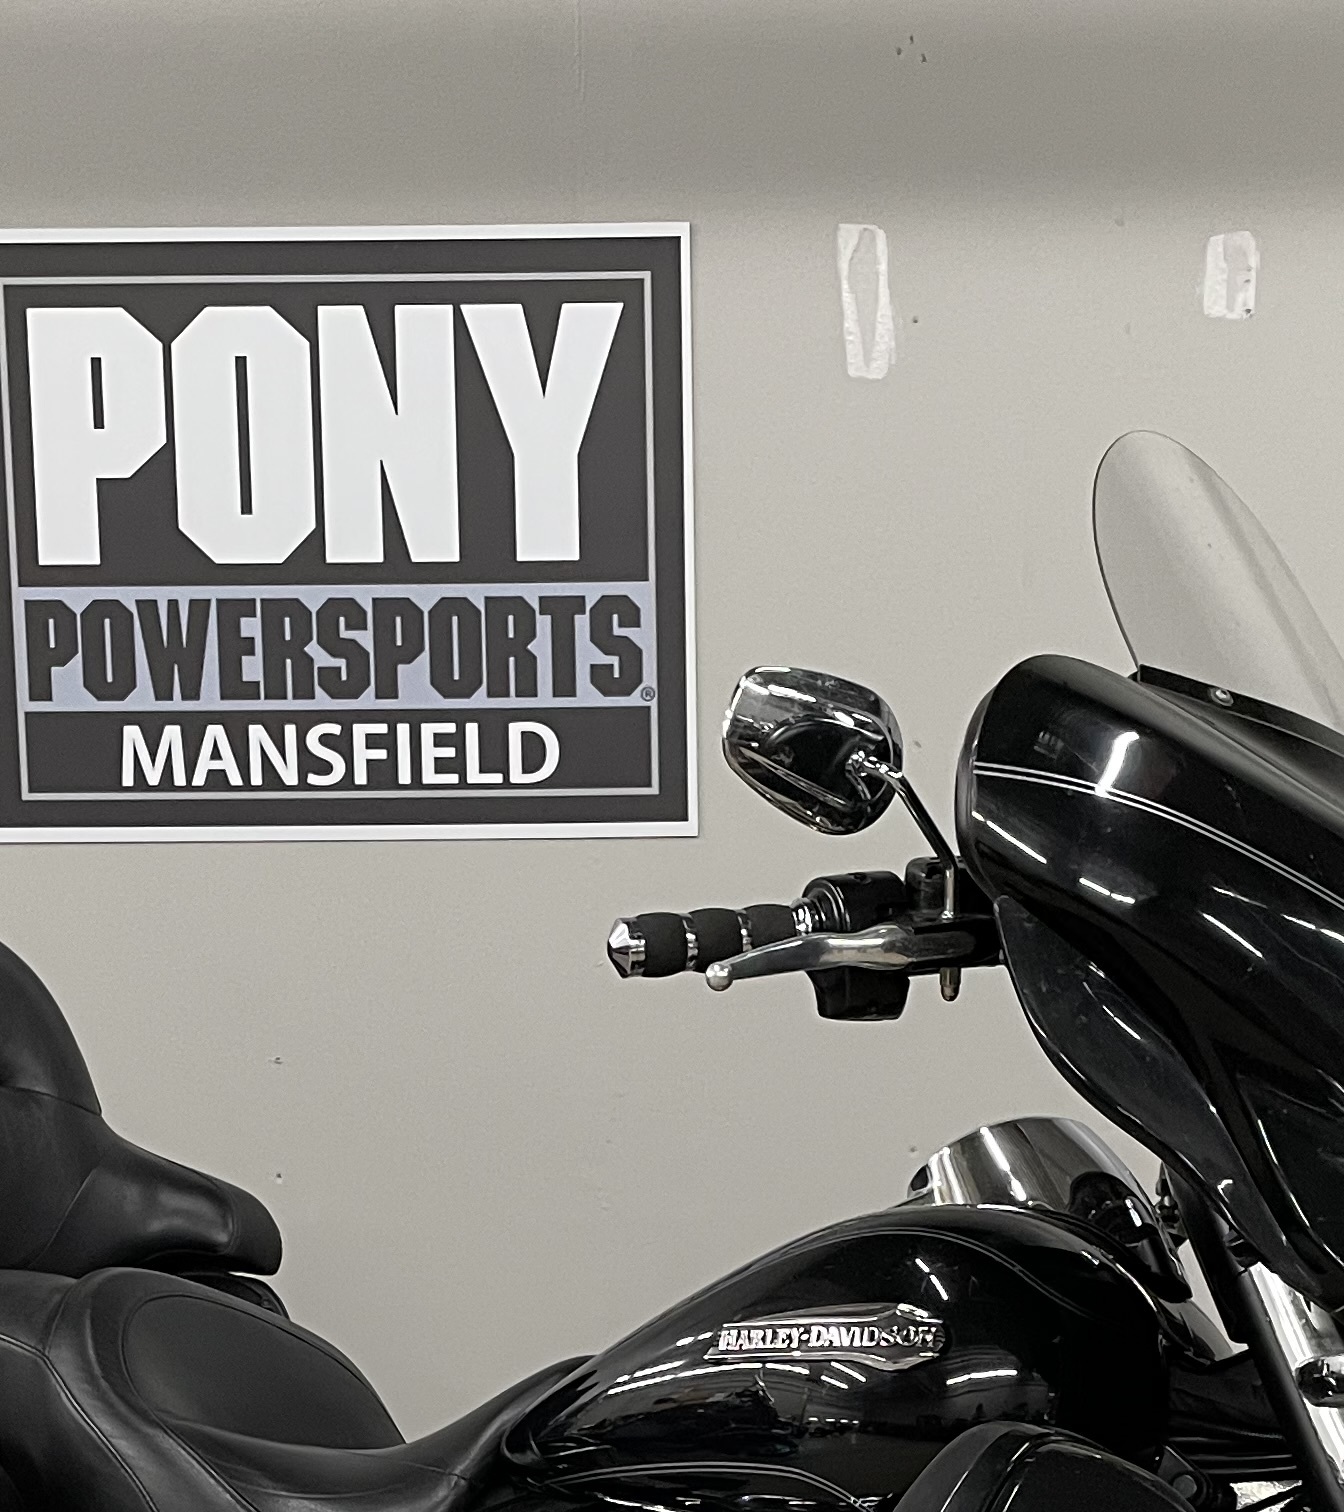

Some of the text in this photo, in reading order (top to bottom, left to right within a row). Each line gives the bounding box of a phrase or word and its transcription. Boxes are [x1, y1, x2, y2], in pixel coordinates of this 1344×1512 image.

[26, 302, 624, 566] PONY
[23, 595, 643, 702] POWERSPORTS
[120, 720, 561, 788] MANSFIELD
